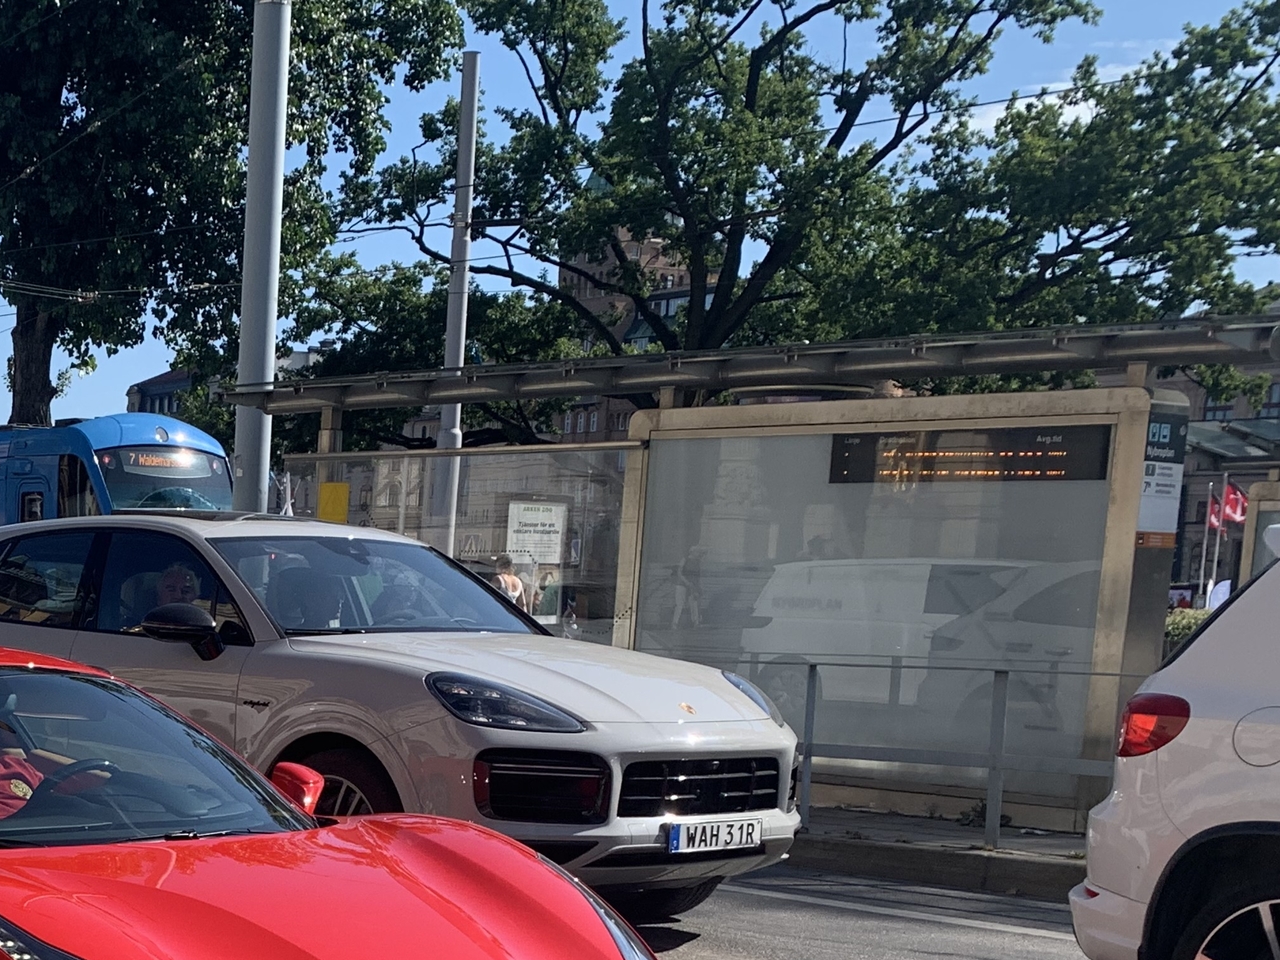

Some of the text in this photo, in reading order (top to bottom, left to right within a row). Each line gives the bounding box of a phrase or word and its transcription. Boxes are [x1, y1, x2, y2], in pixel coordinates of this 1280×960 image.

[129, 453, 135, 465] 7
[687, 825, 721, 848] WAH
[725, 823, 755, 845] 31R
